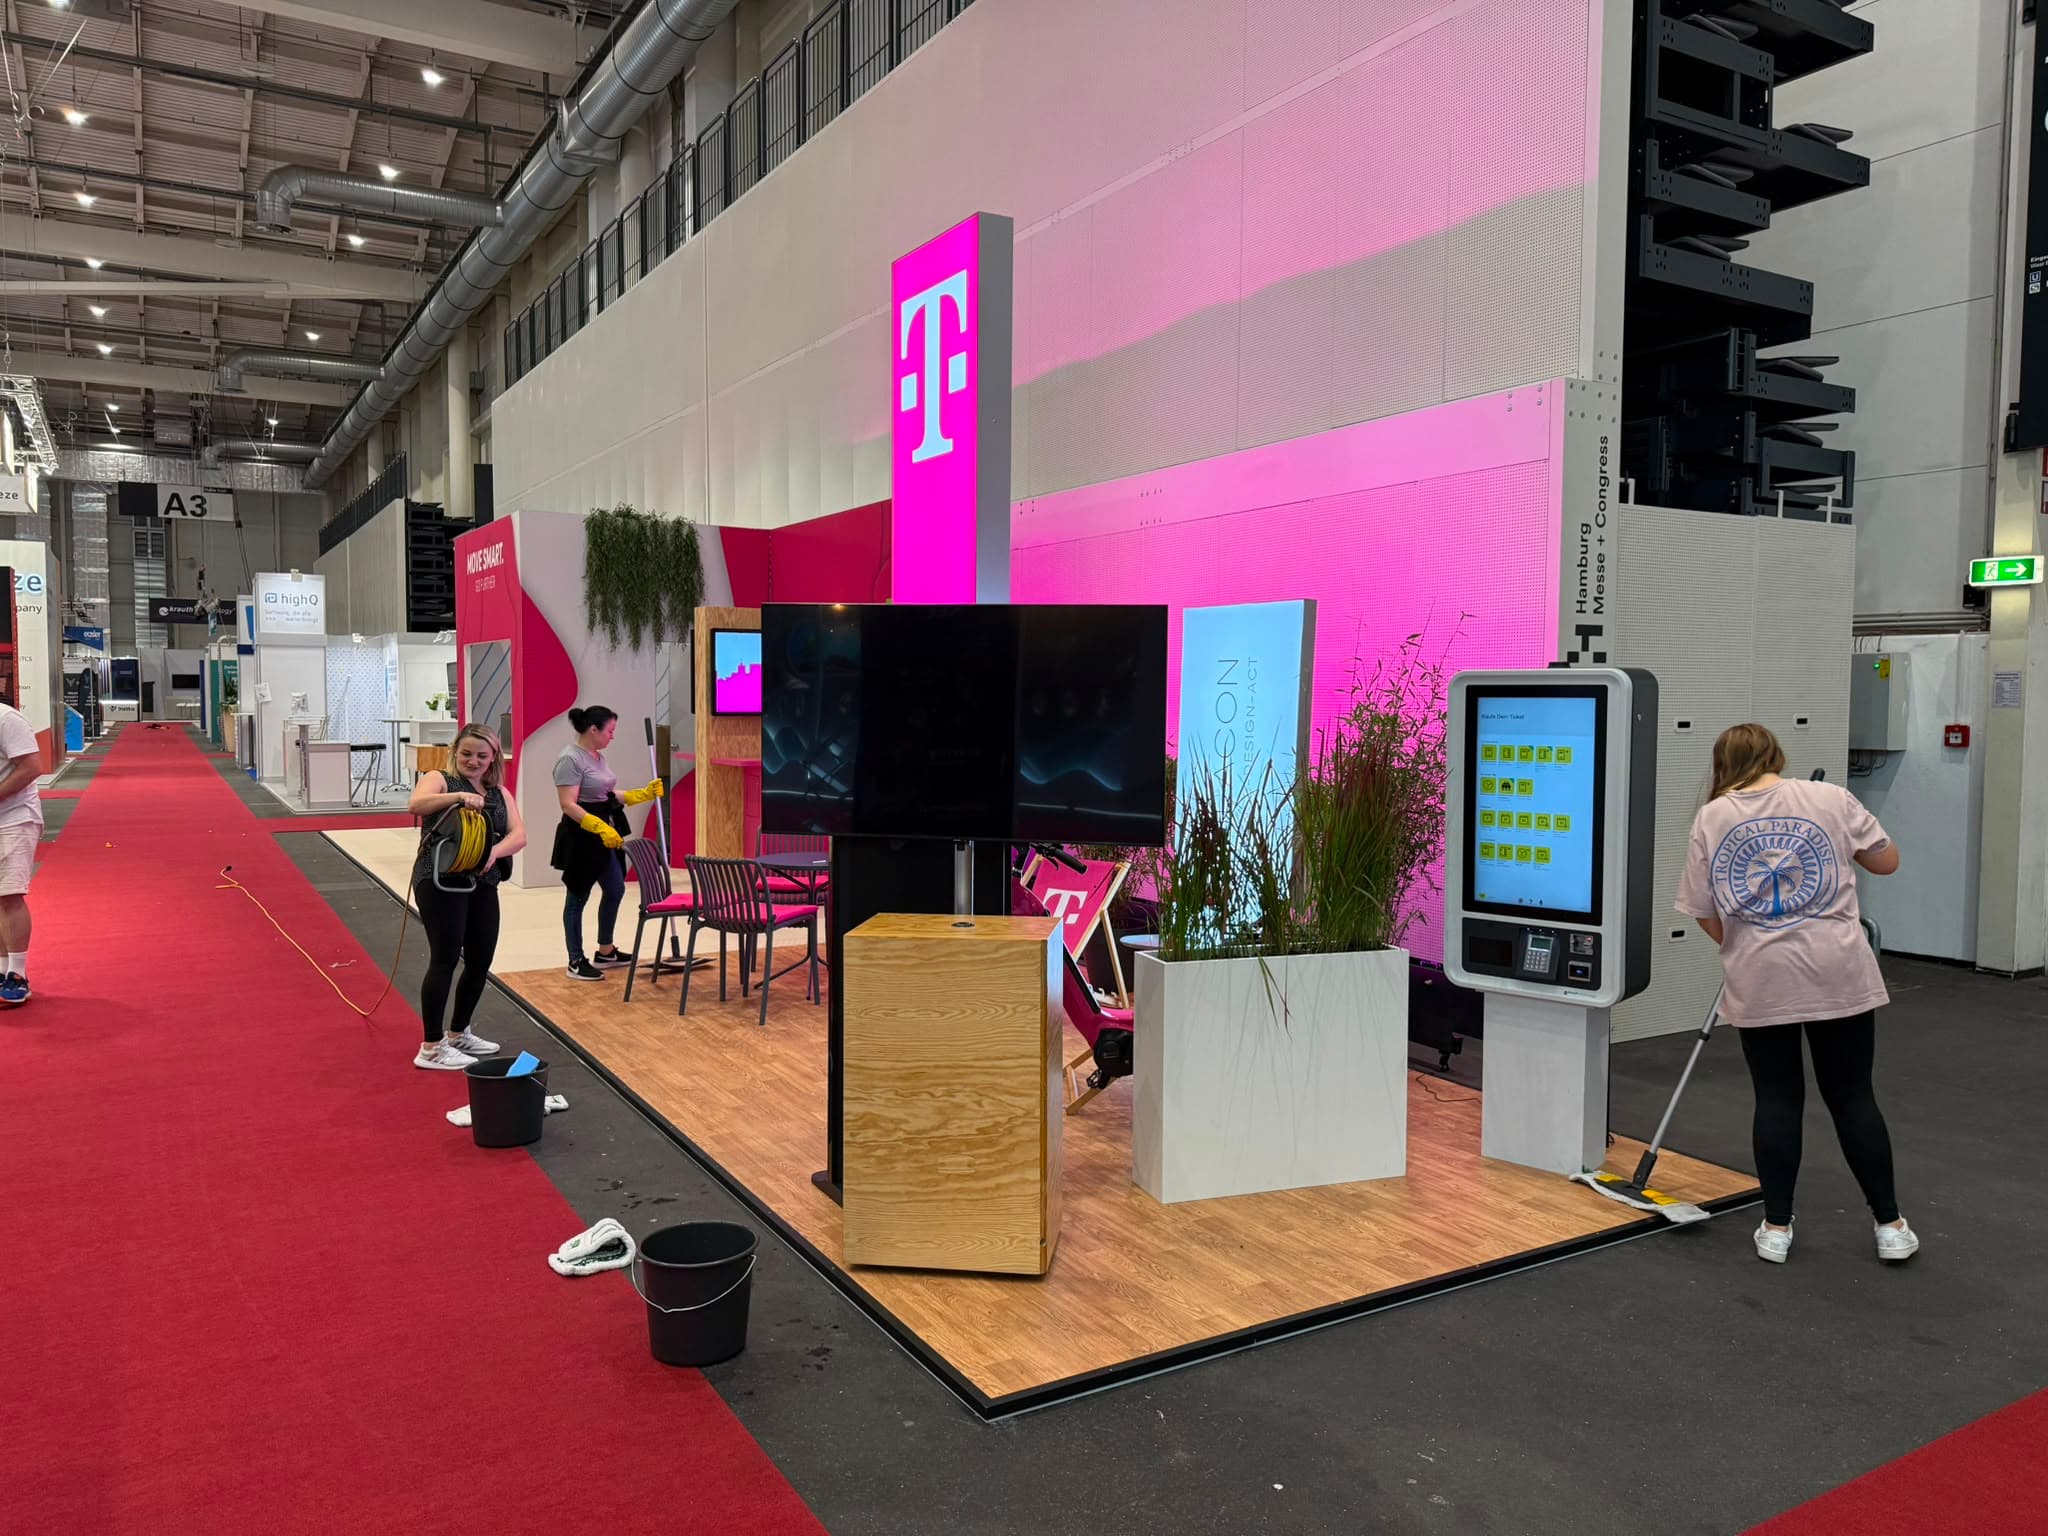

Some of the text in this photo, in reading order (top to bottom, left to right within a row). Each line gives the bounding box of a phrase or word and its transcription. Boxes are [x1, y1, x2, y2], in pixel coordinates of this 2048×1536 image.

[163, 492, 208, 517] A3
[1592, 435, 1611, 615] Messe + Congress
[467, 541, 504, 575] MOVE SMART.
[1576, 522, 1592, 615] Hamburg
[1715, 820, 1833, 885] TROPICAL PARADISE
